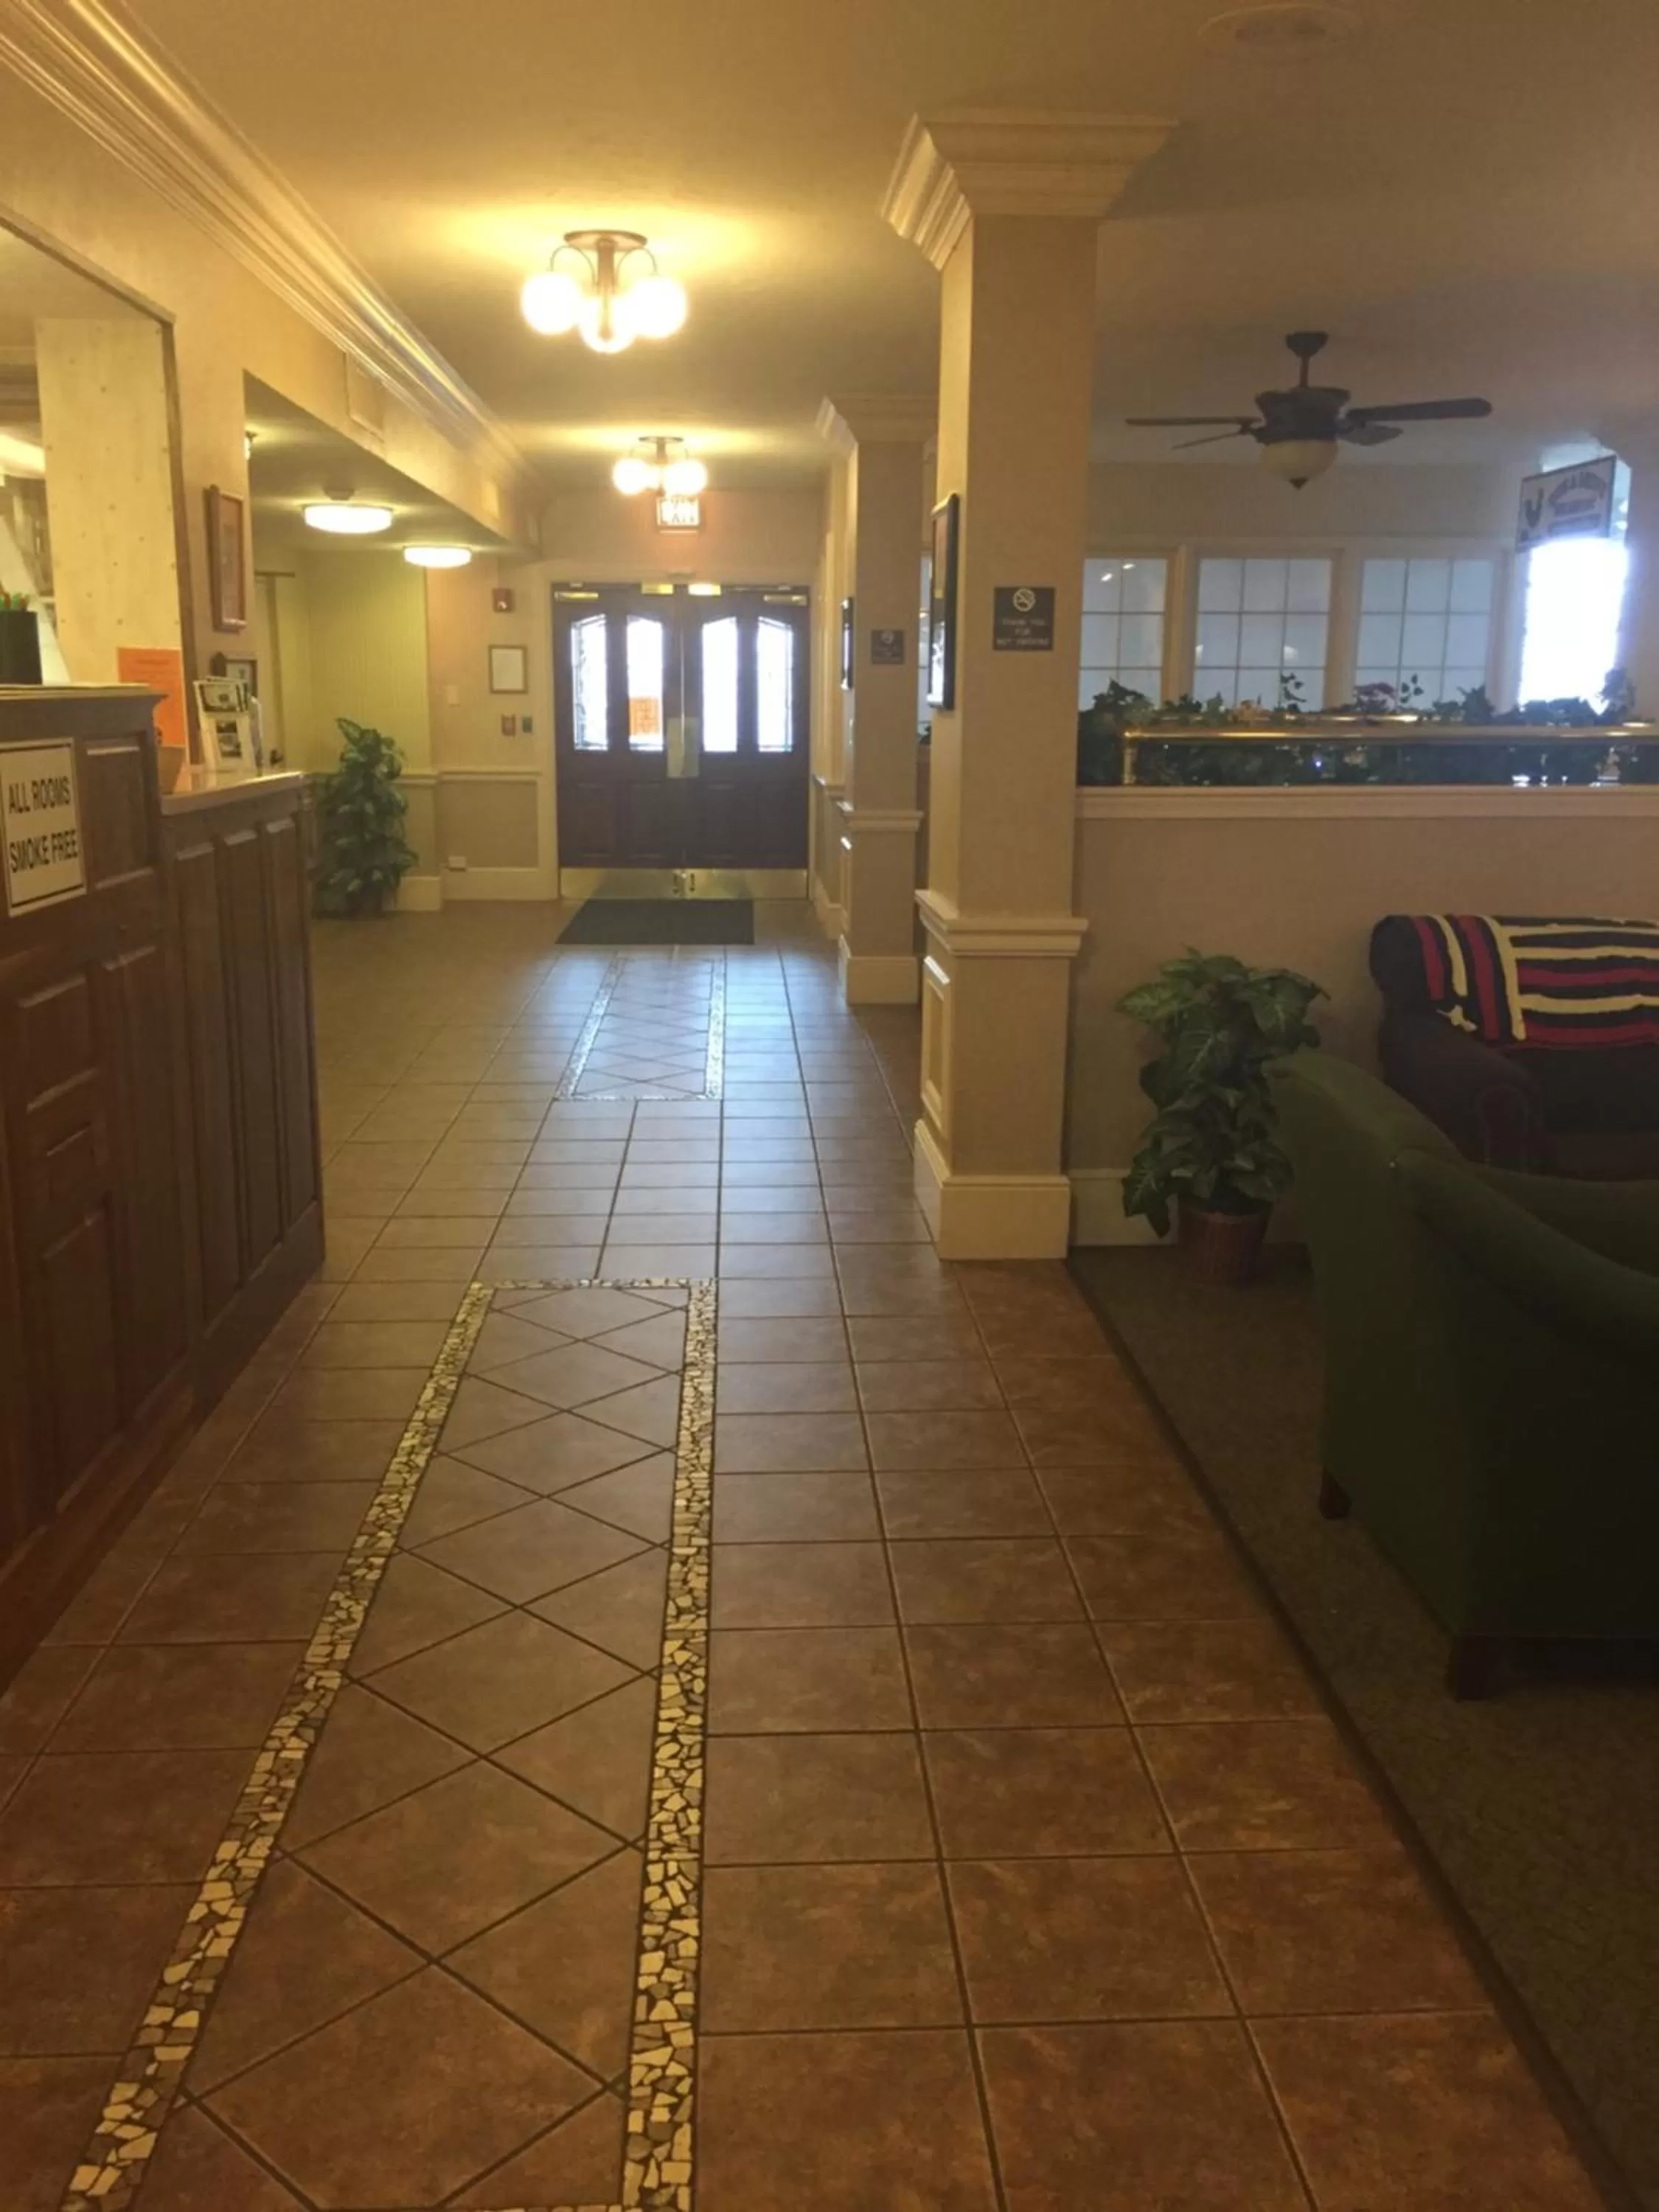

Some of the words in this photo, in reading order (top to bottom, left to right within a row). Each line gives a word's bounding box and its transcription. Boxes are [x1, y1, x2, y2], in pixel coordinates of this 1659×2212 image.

[8, 782, 30, 814] ALL
[32, 776, 71, 810] ROOMS
[10, 835, 50, 873] SMOKE
[51, 829, 77, 863] FREE
